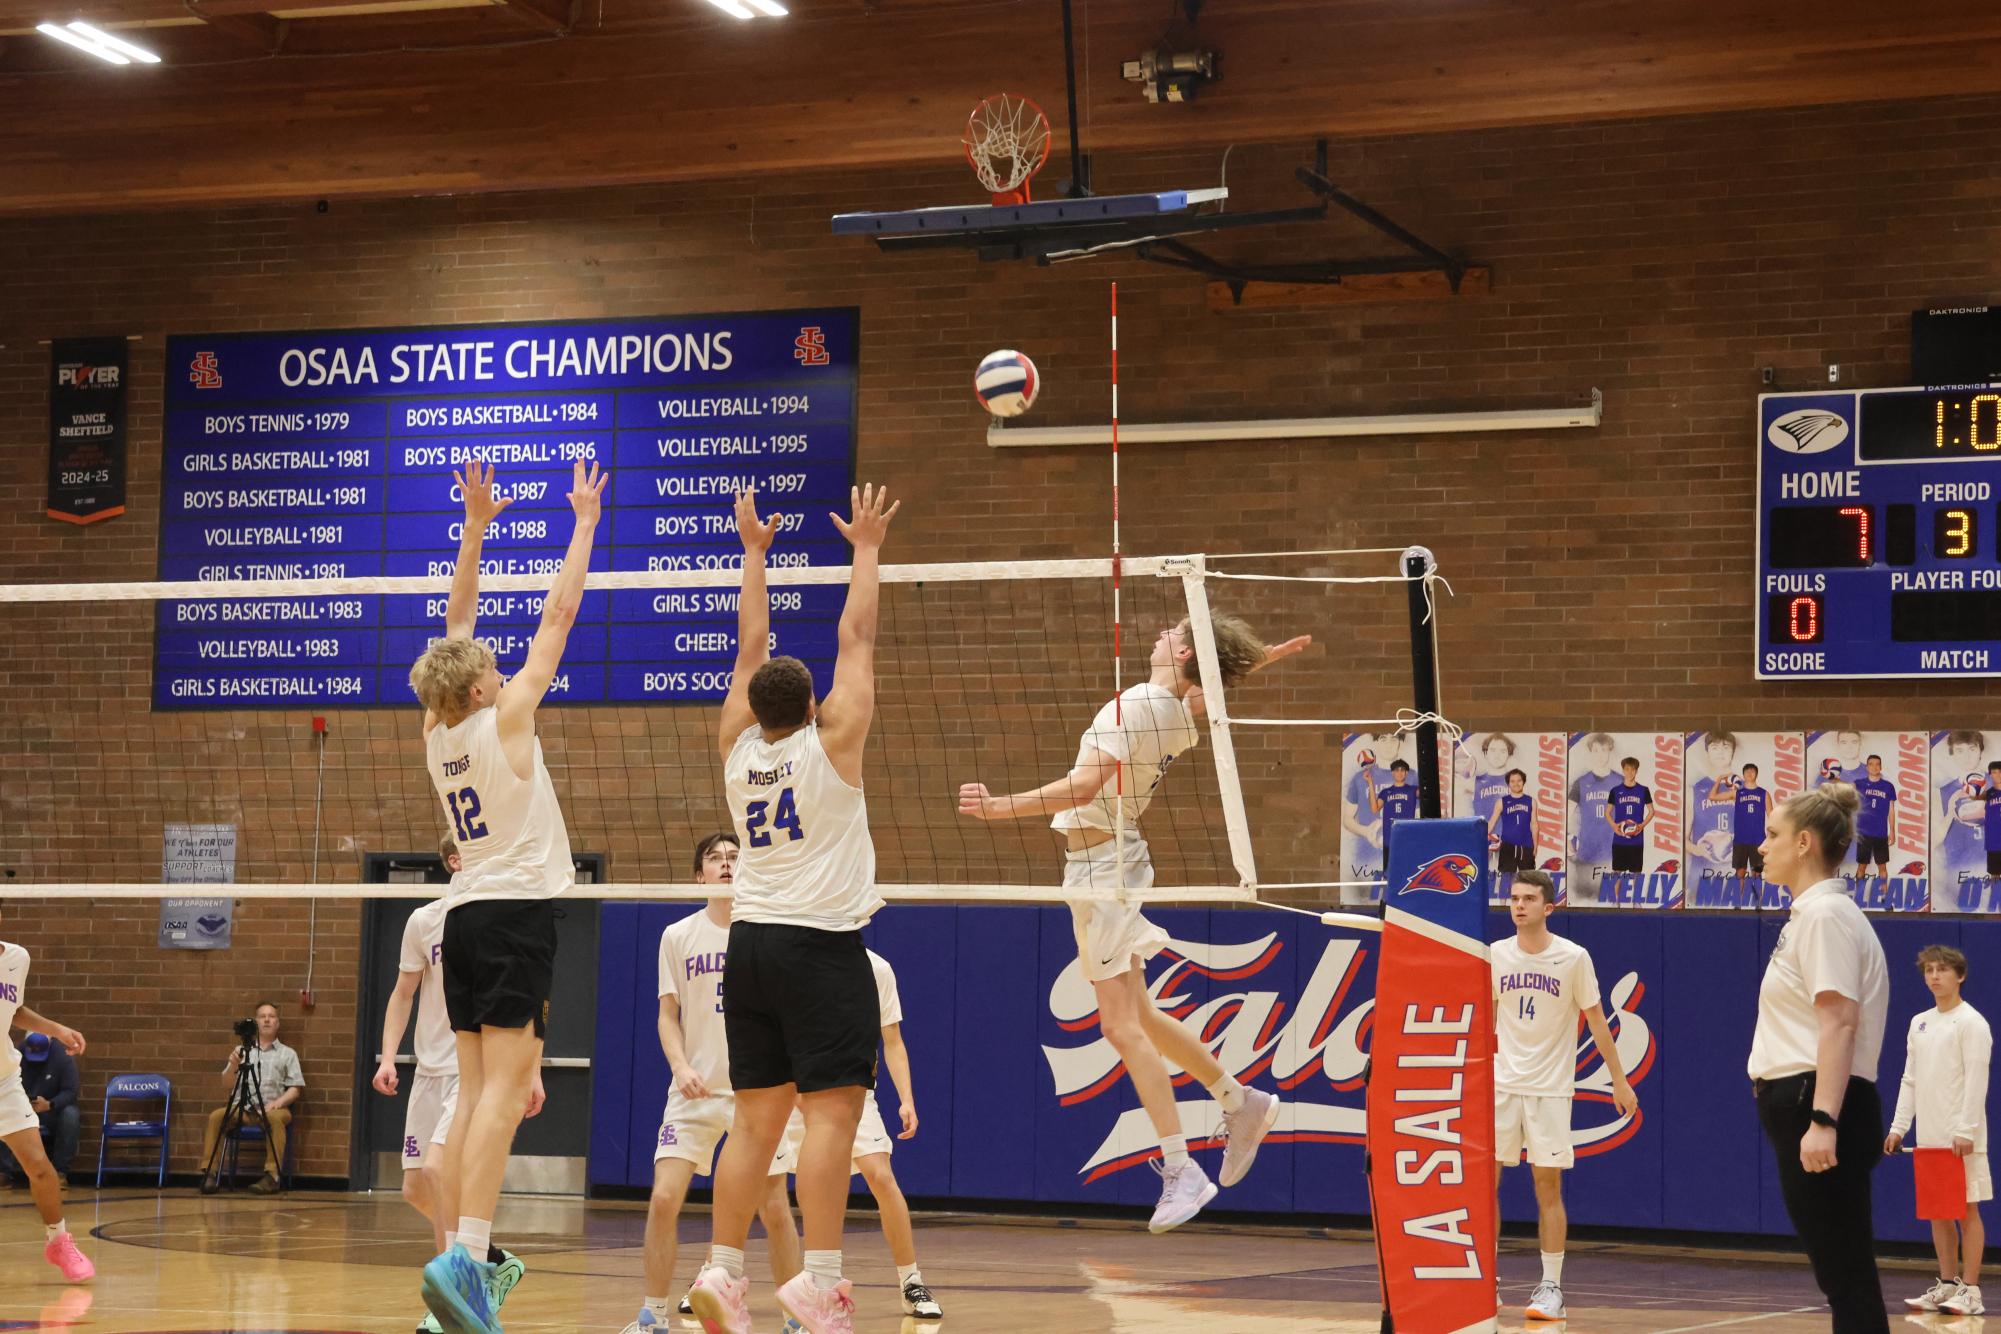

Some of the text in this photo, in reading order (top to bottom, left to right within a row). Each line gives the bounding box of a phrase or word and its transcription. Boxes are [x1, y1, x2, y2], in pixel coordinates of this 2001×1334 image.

[1929, 306, 1988, 316] DAKTRONICS
[279, 331, 732, 388] OSAA STATE CHAMPIONS
[1928, 383, 1987, 392] DAKTRONICS
[72, 413, 106, 425] VANCE
[205, 416, 245, 434] BOYS
[406, 408, 448, 427] BOYS
[59, 425, 113, 437] SHEFFIELD
[183, 454, 227, 472] GIRLS
[404, 447, 446, 466] BOYS
[61, 469, 109, 485] 2024-25
[1781, 471, 1861, 499] HOME
[183, 491, 224, 509] BOYS
[1922, 482, 1990, 502] PERIOD
[655, 516, 698, 536] BOYS
[1840, 508, 1868, 559] 7
[1946, 511, 1969, 555] 3
[648, 555, 691, 572] BOYS
[198, 566, 243, 582] GIRLS
[1766, 574, 1826, 592] FOULS
[1891, 571, 1964, 591] PLAYER
[177, 603, 217, 621] BOYS
[653, 594, 700, 613] GIRLS
[1791, 597, 1816, 640] 0
[1766, 652, 1826, 671] SCORE
[1921, 650, 1989, 669] MATCH
[171, 679, 215, 696] GIRLS
[644, 673, 687, 691] BOYS
[1538, 735, 1565, 852] FALCONS
[1654, 735, 1683, 854] FALCONS
[1898, 734, 1927, 856] FALCONS
[447, 786, 489, 842] 12
[746, 787, 804, 848] 24
[1598, 874, 1678, 905] KELLY
[1500, 972, 1561, 998] FALCONS
[1519, 995, 1535, 1020] 14
[118, 1082, 159, 1091] FALCONS
[1393, 1002, 1484, 1280] LA SALLE
